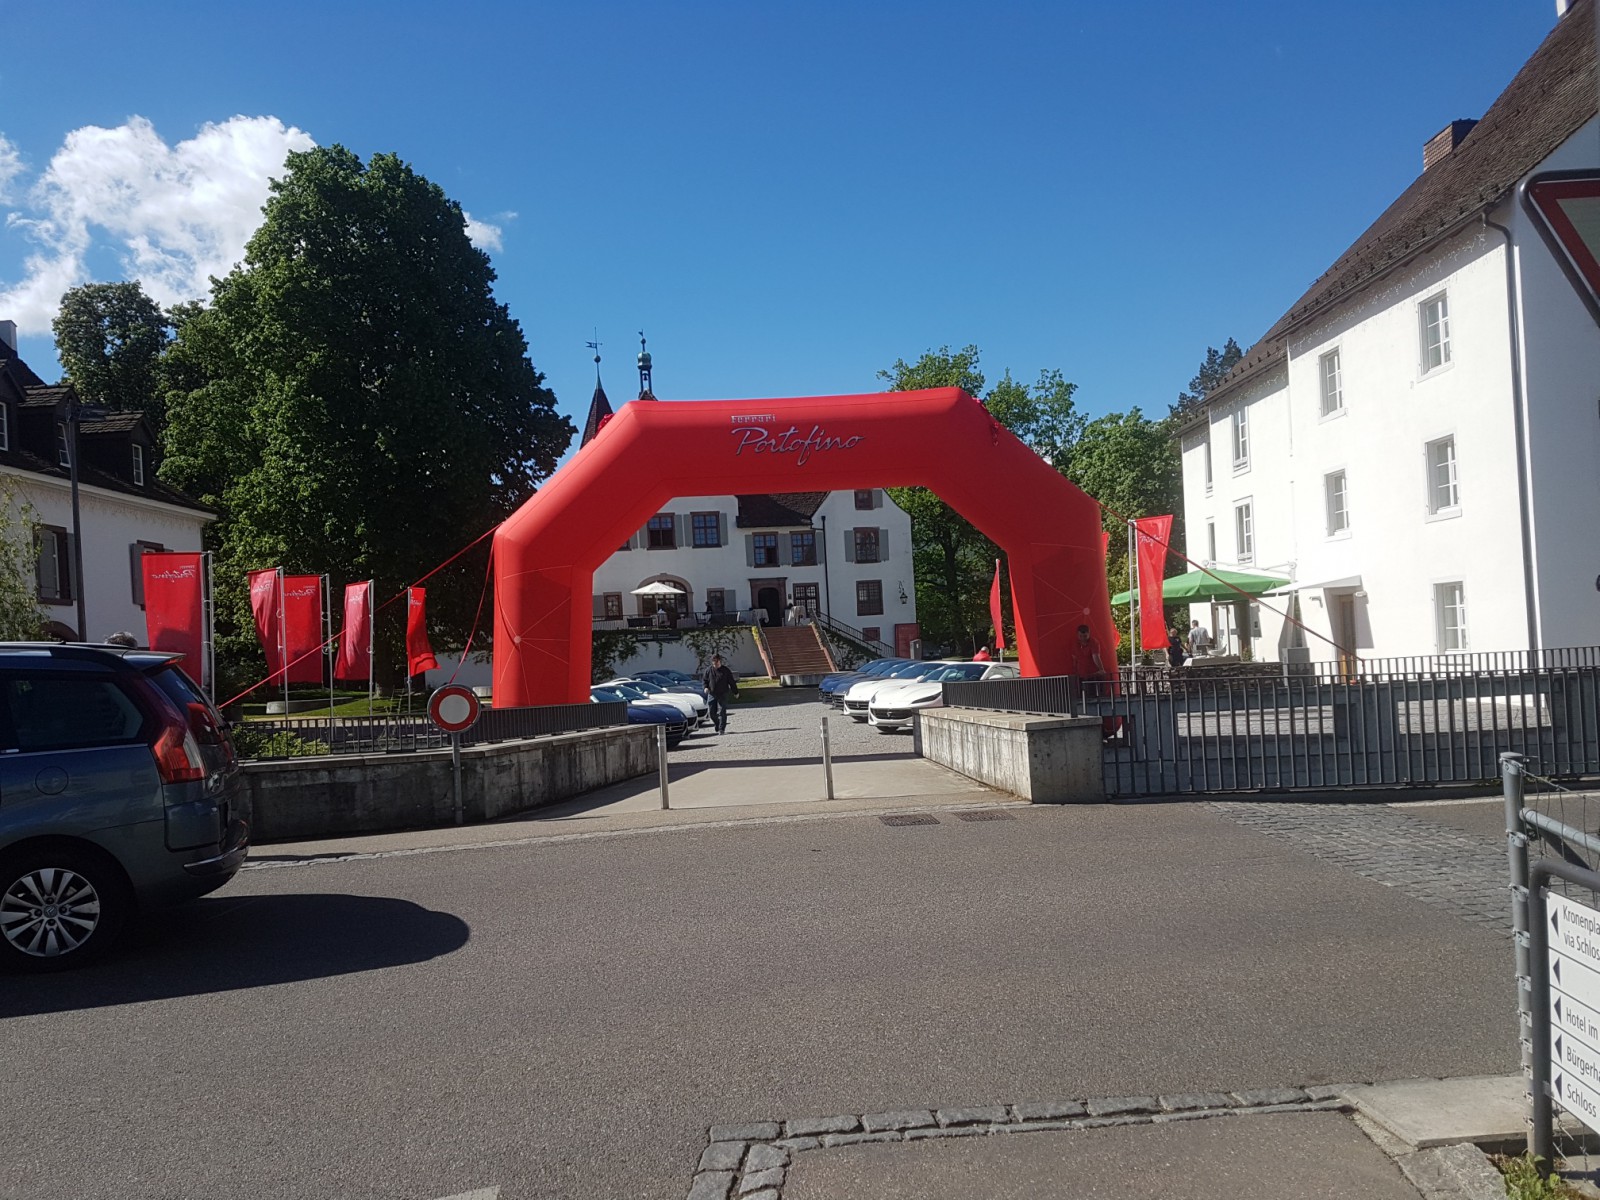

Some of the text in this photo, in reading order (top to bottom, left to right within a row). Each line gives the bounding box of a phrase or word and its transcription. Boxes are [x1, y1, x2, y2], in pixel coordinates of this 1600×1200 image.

[731, 413, 776, 424] Ferrari
[731, 425, 865, 467] Portofino
[1563, 930, 1575, 948] via
[1566, 1006, 1599, 1041] Hotel im
[1566, 1083, 1597, 1118] Schloss
